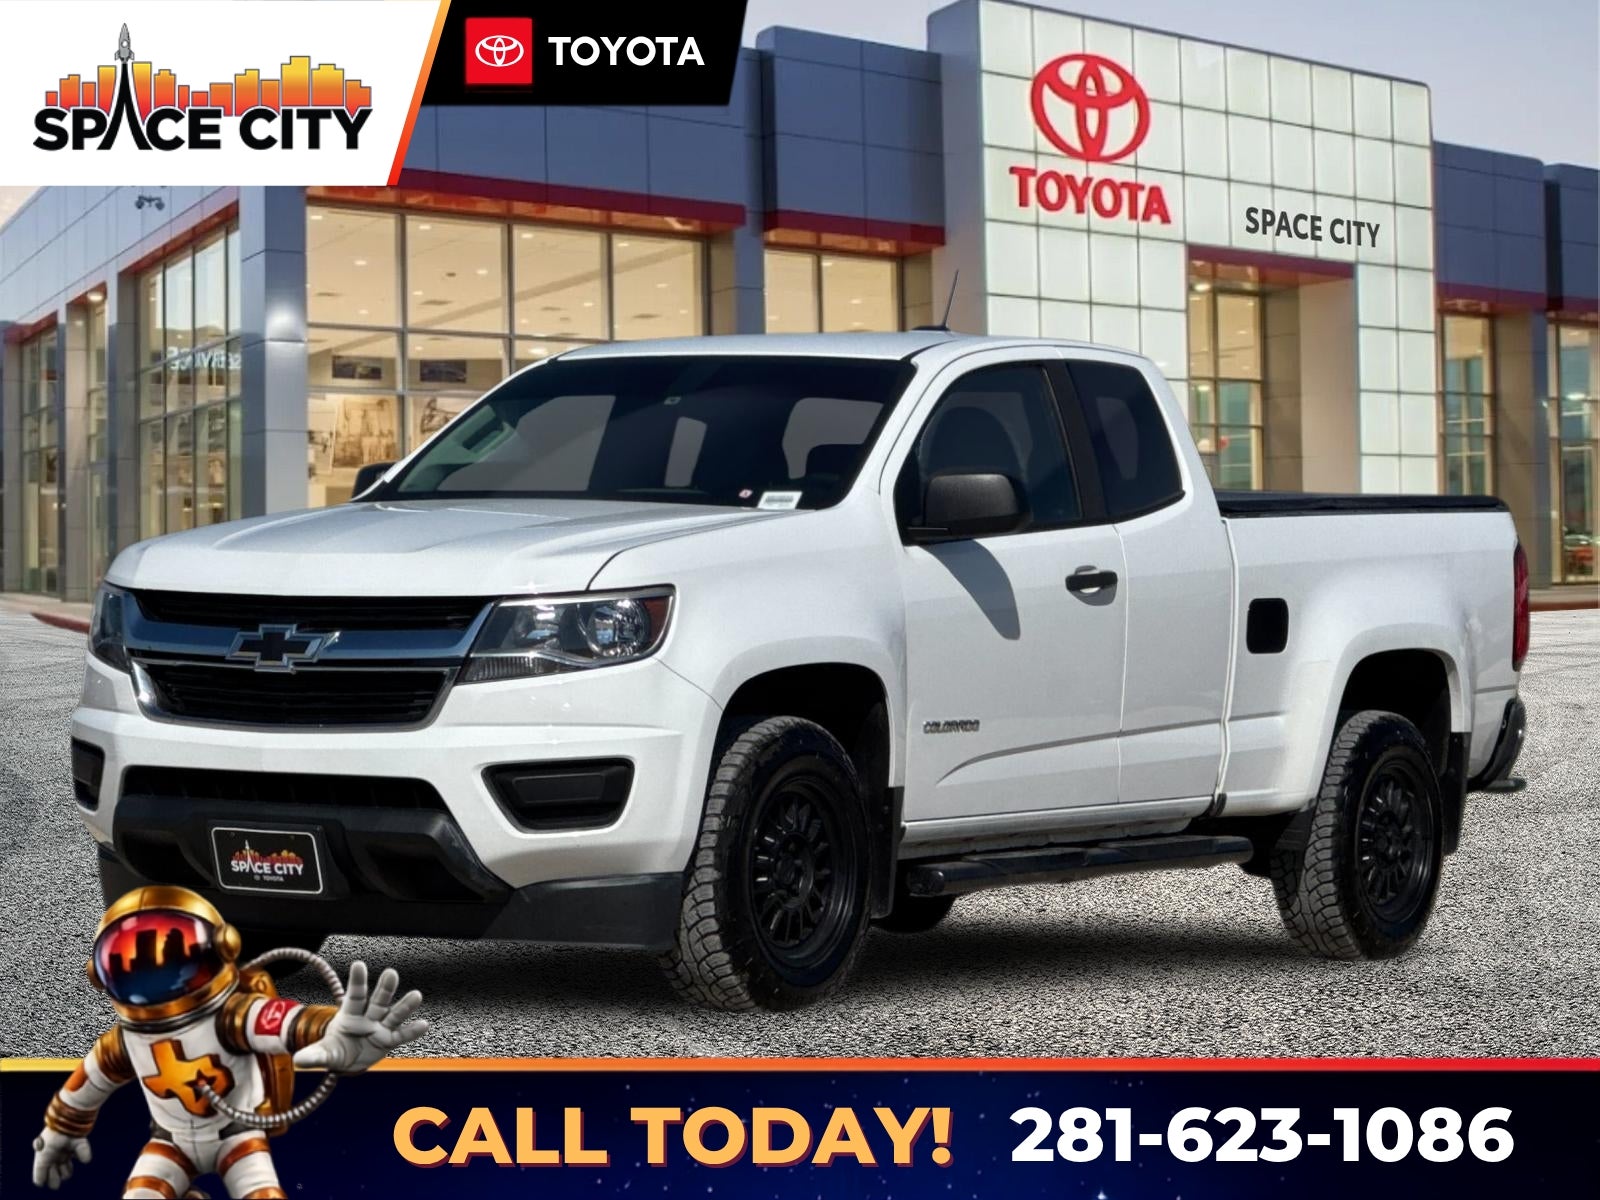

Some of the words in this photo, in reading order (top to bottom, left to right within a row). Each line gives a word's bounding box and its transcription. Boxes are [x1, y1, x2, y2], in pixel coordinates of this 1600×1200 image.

[1009, 166, 1171, 224] TOYOTA
[1245, 207, 1323, 241] SPACE
[1329, 218, 1381, 248] CITY
[230, 858, 271, 874] SPACE
[274, 863, 304, 876] CITY
